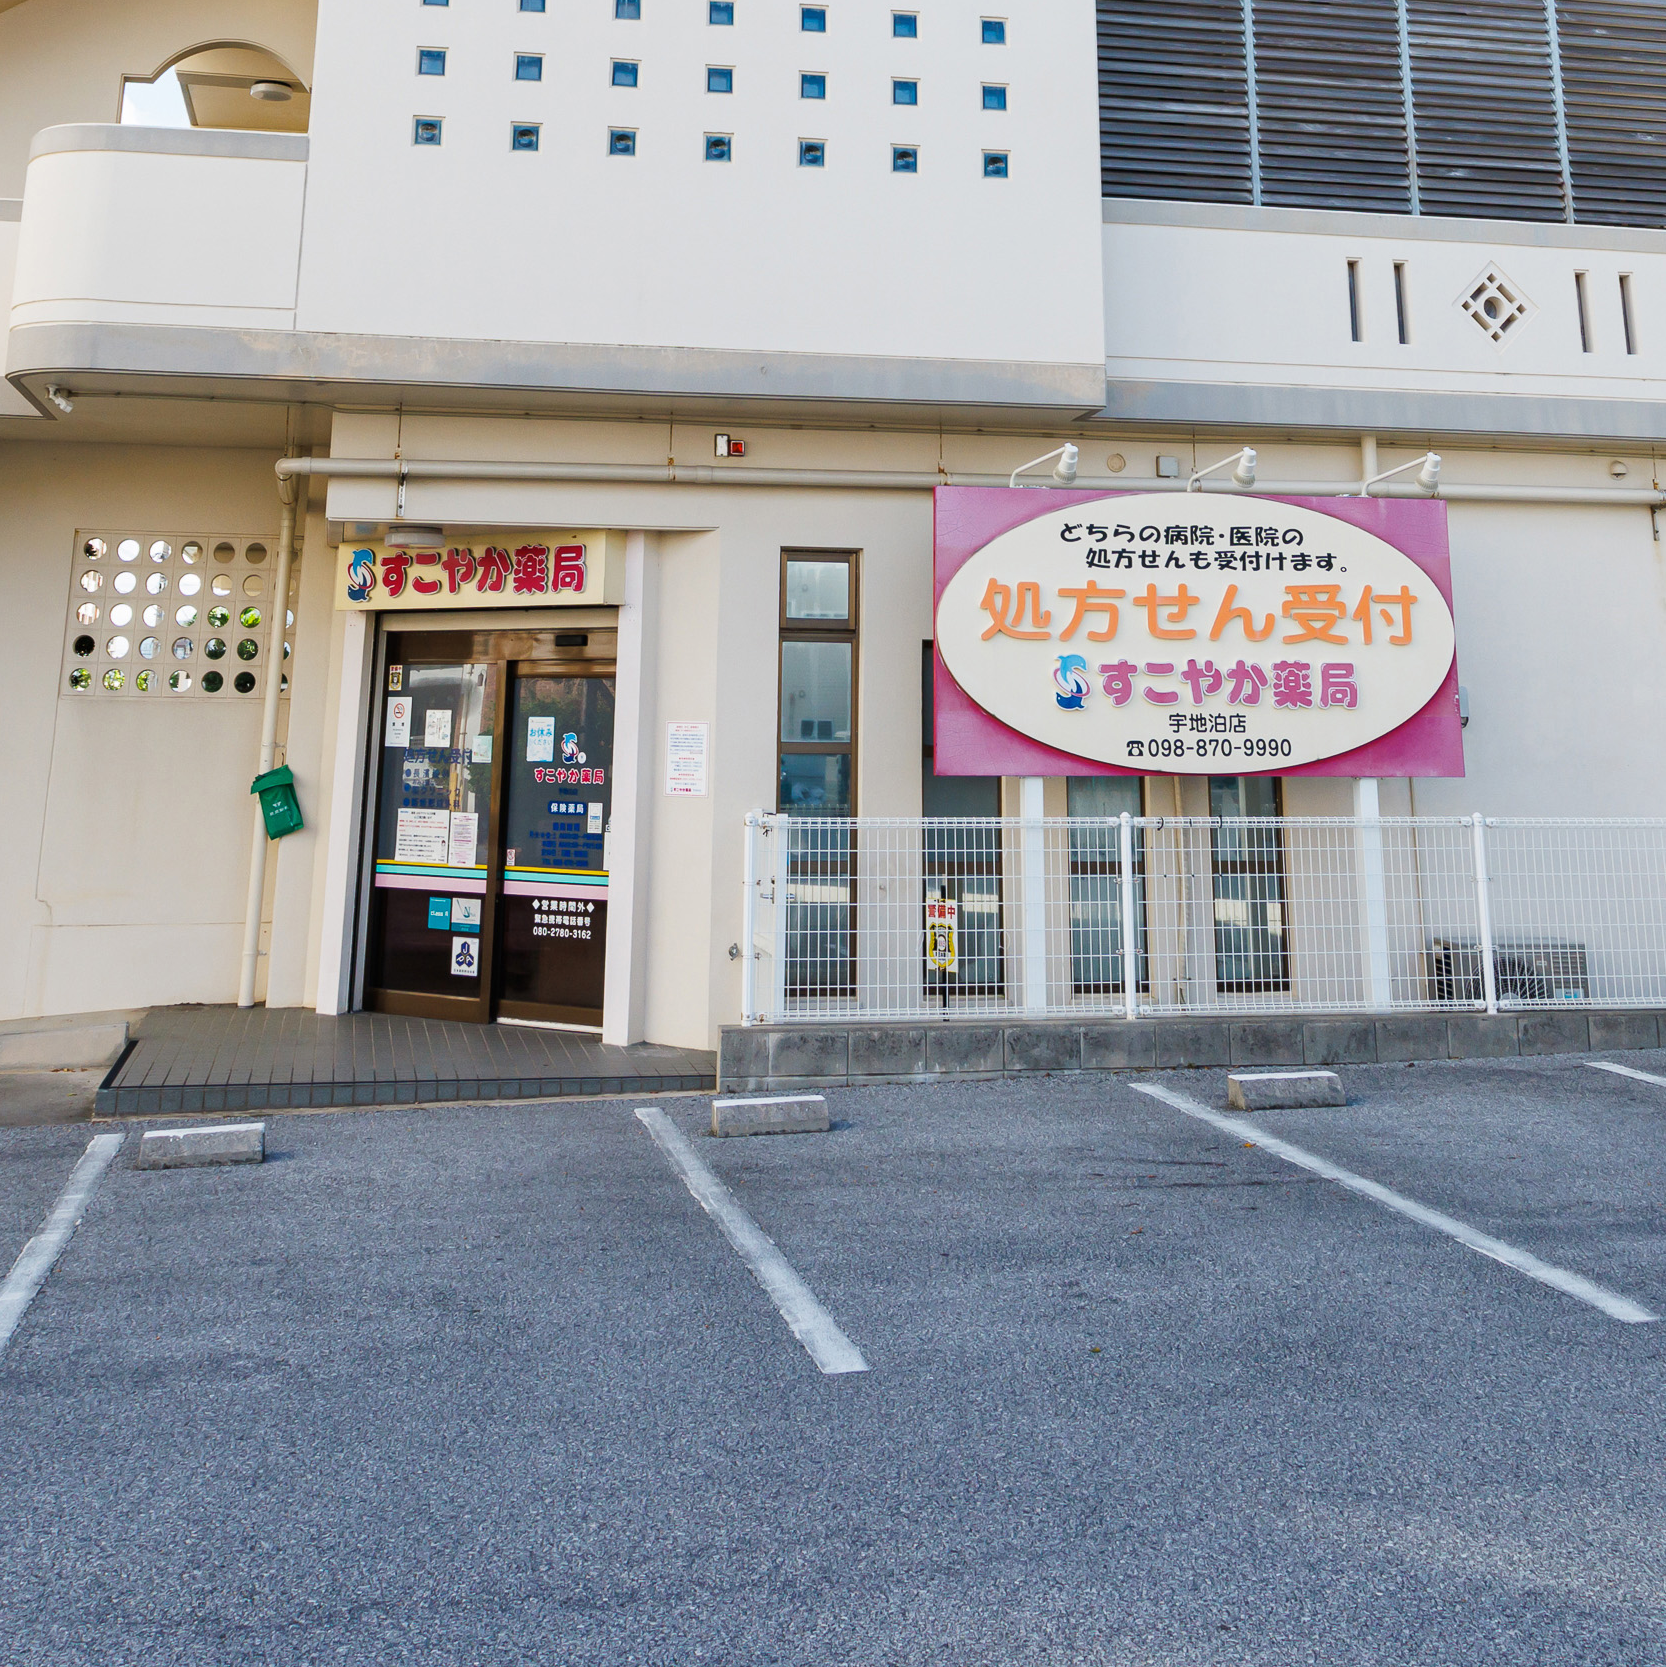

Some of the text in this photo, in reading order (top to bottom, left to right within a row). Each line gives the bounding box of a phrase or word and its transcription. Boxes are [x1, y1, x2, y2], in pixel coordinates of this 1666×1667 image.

[1059, 522, 1305, 548] どちらの病院・医院の
[379, 542, 589, 598] すこやか薬局
[1085, 547, 1348, 573] 処方せんも受付けます。
[979, 577, 1419, 646] 処方せん受付
[1098, 658, 1361, 710] すこやか薬局
[1168, 713, 1247, 733] 宇地泊店
[1148, 738, 1292, 758] 098-870-9990
[534, 767, 605, 785] すこやか薬局
[550, 802, 585, 814] 保険薬局
[541, 899, 586, 913] 営業時間外
[532, 926, 592, 940] 080-2780-3162
